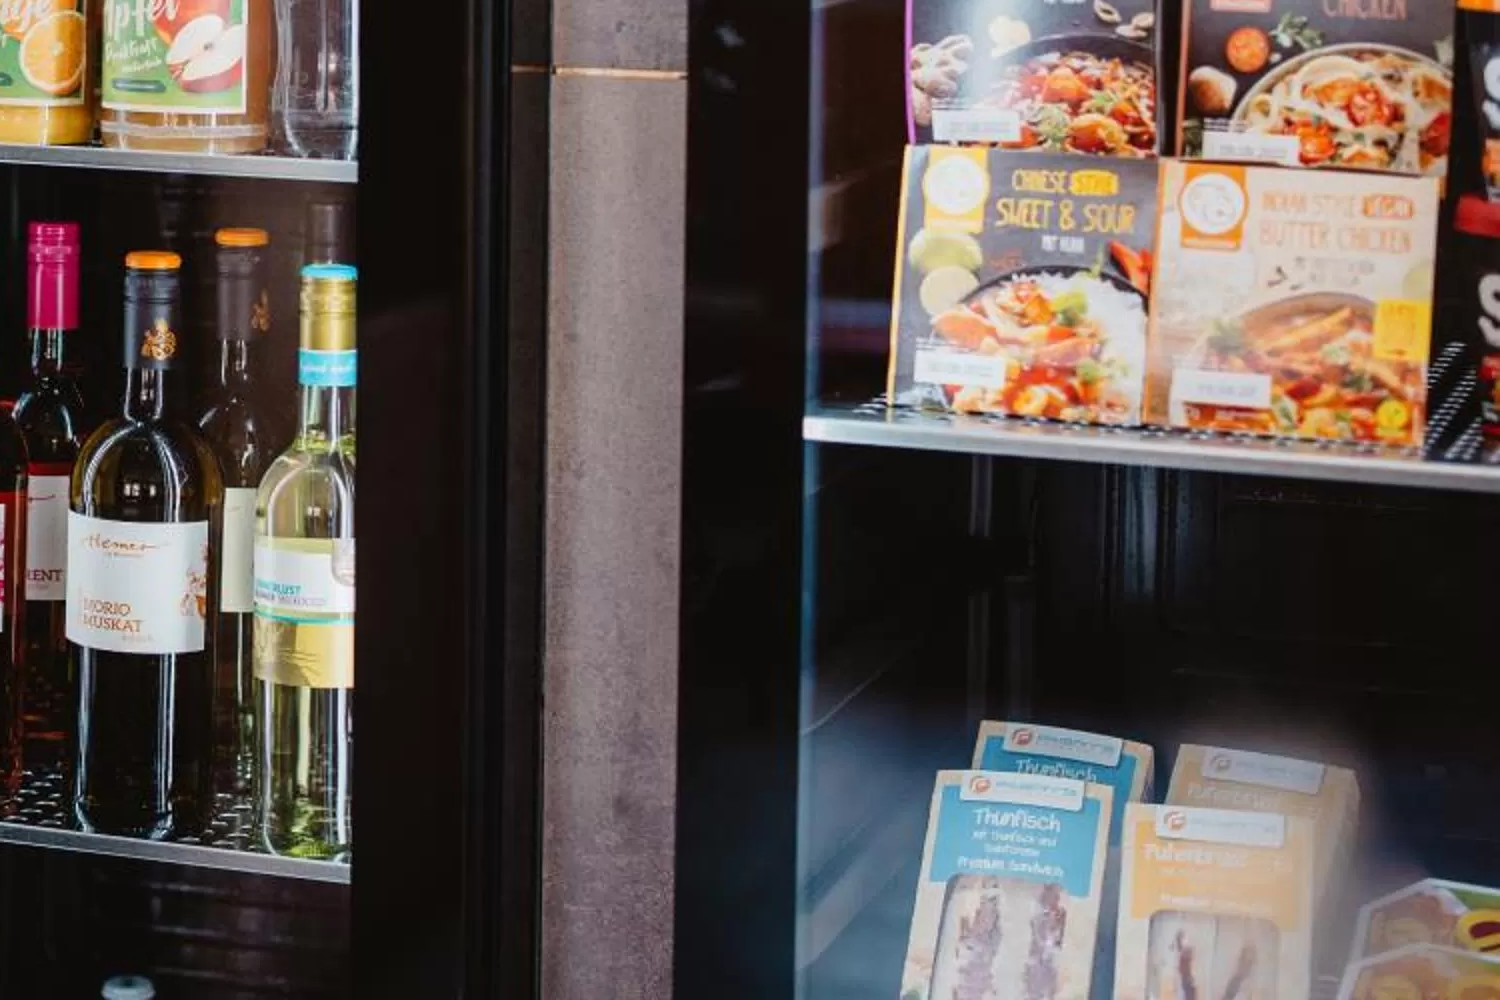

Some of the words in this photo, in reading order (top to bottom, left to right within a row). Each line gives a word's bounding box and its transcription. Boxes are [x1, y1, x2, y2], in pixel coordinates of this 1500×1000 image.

[996, 198, 1055, 229] SWEET
[1059, 199, 1076, 231] &
[1082, 202, 1137, 234] SOUR
[973, 807, 1062, 833] Thunfisch
